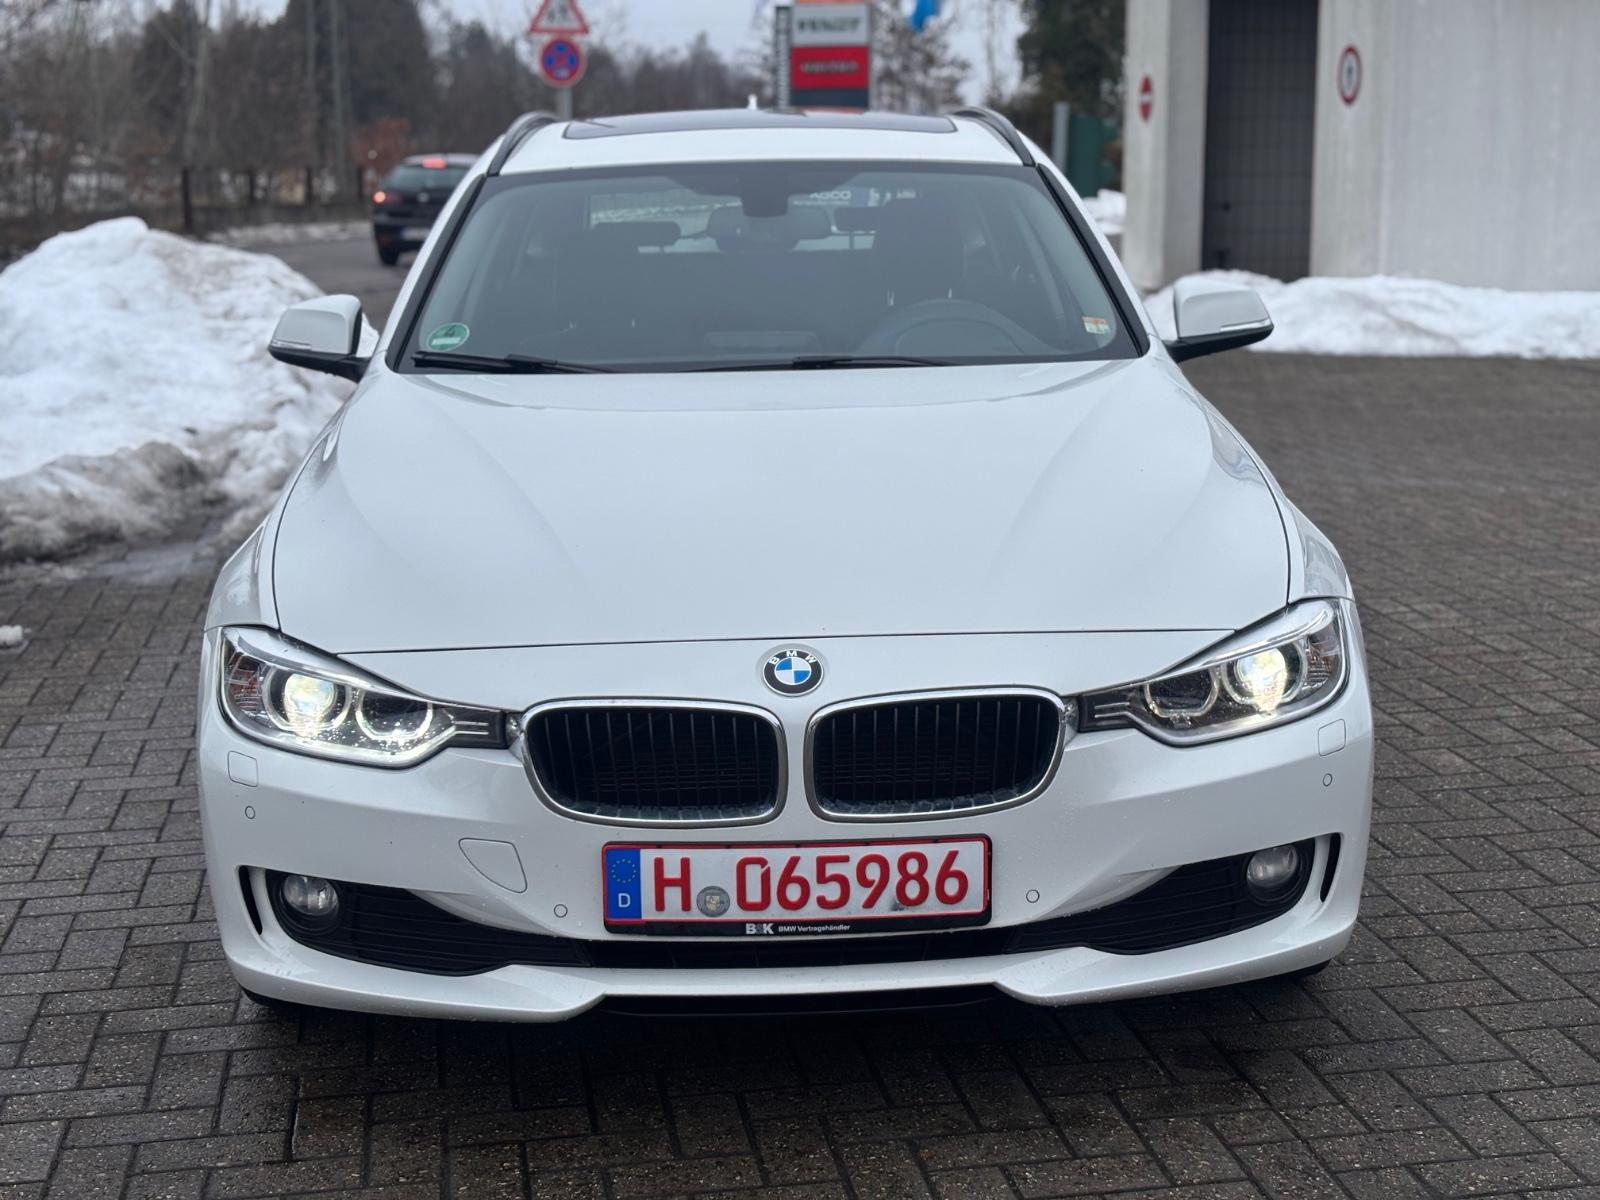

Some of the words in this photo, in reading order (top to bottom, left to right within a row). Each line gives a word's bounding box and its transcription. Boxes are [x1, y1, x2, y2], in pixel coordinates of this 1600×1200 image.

[769, 650, 817, 665] BMW
[653, 856, 692, 912] H
[736, 850, 969, 912] 065986
[617, 892, 631, 908] D
[797, 924, 851, 934] Vertragshändler
